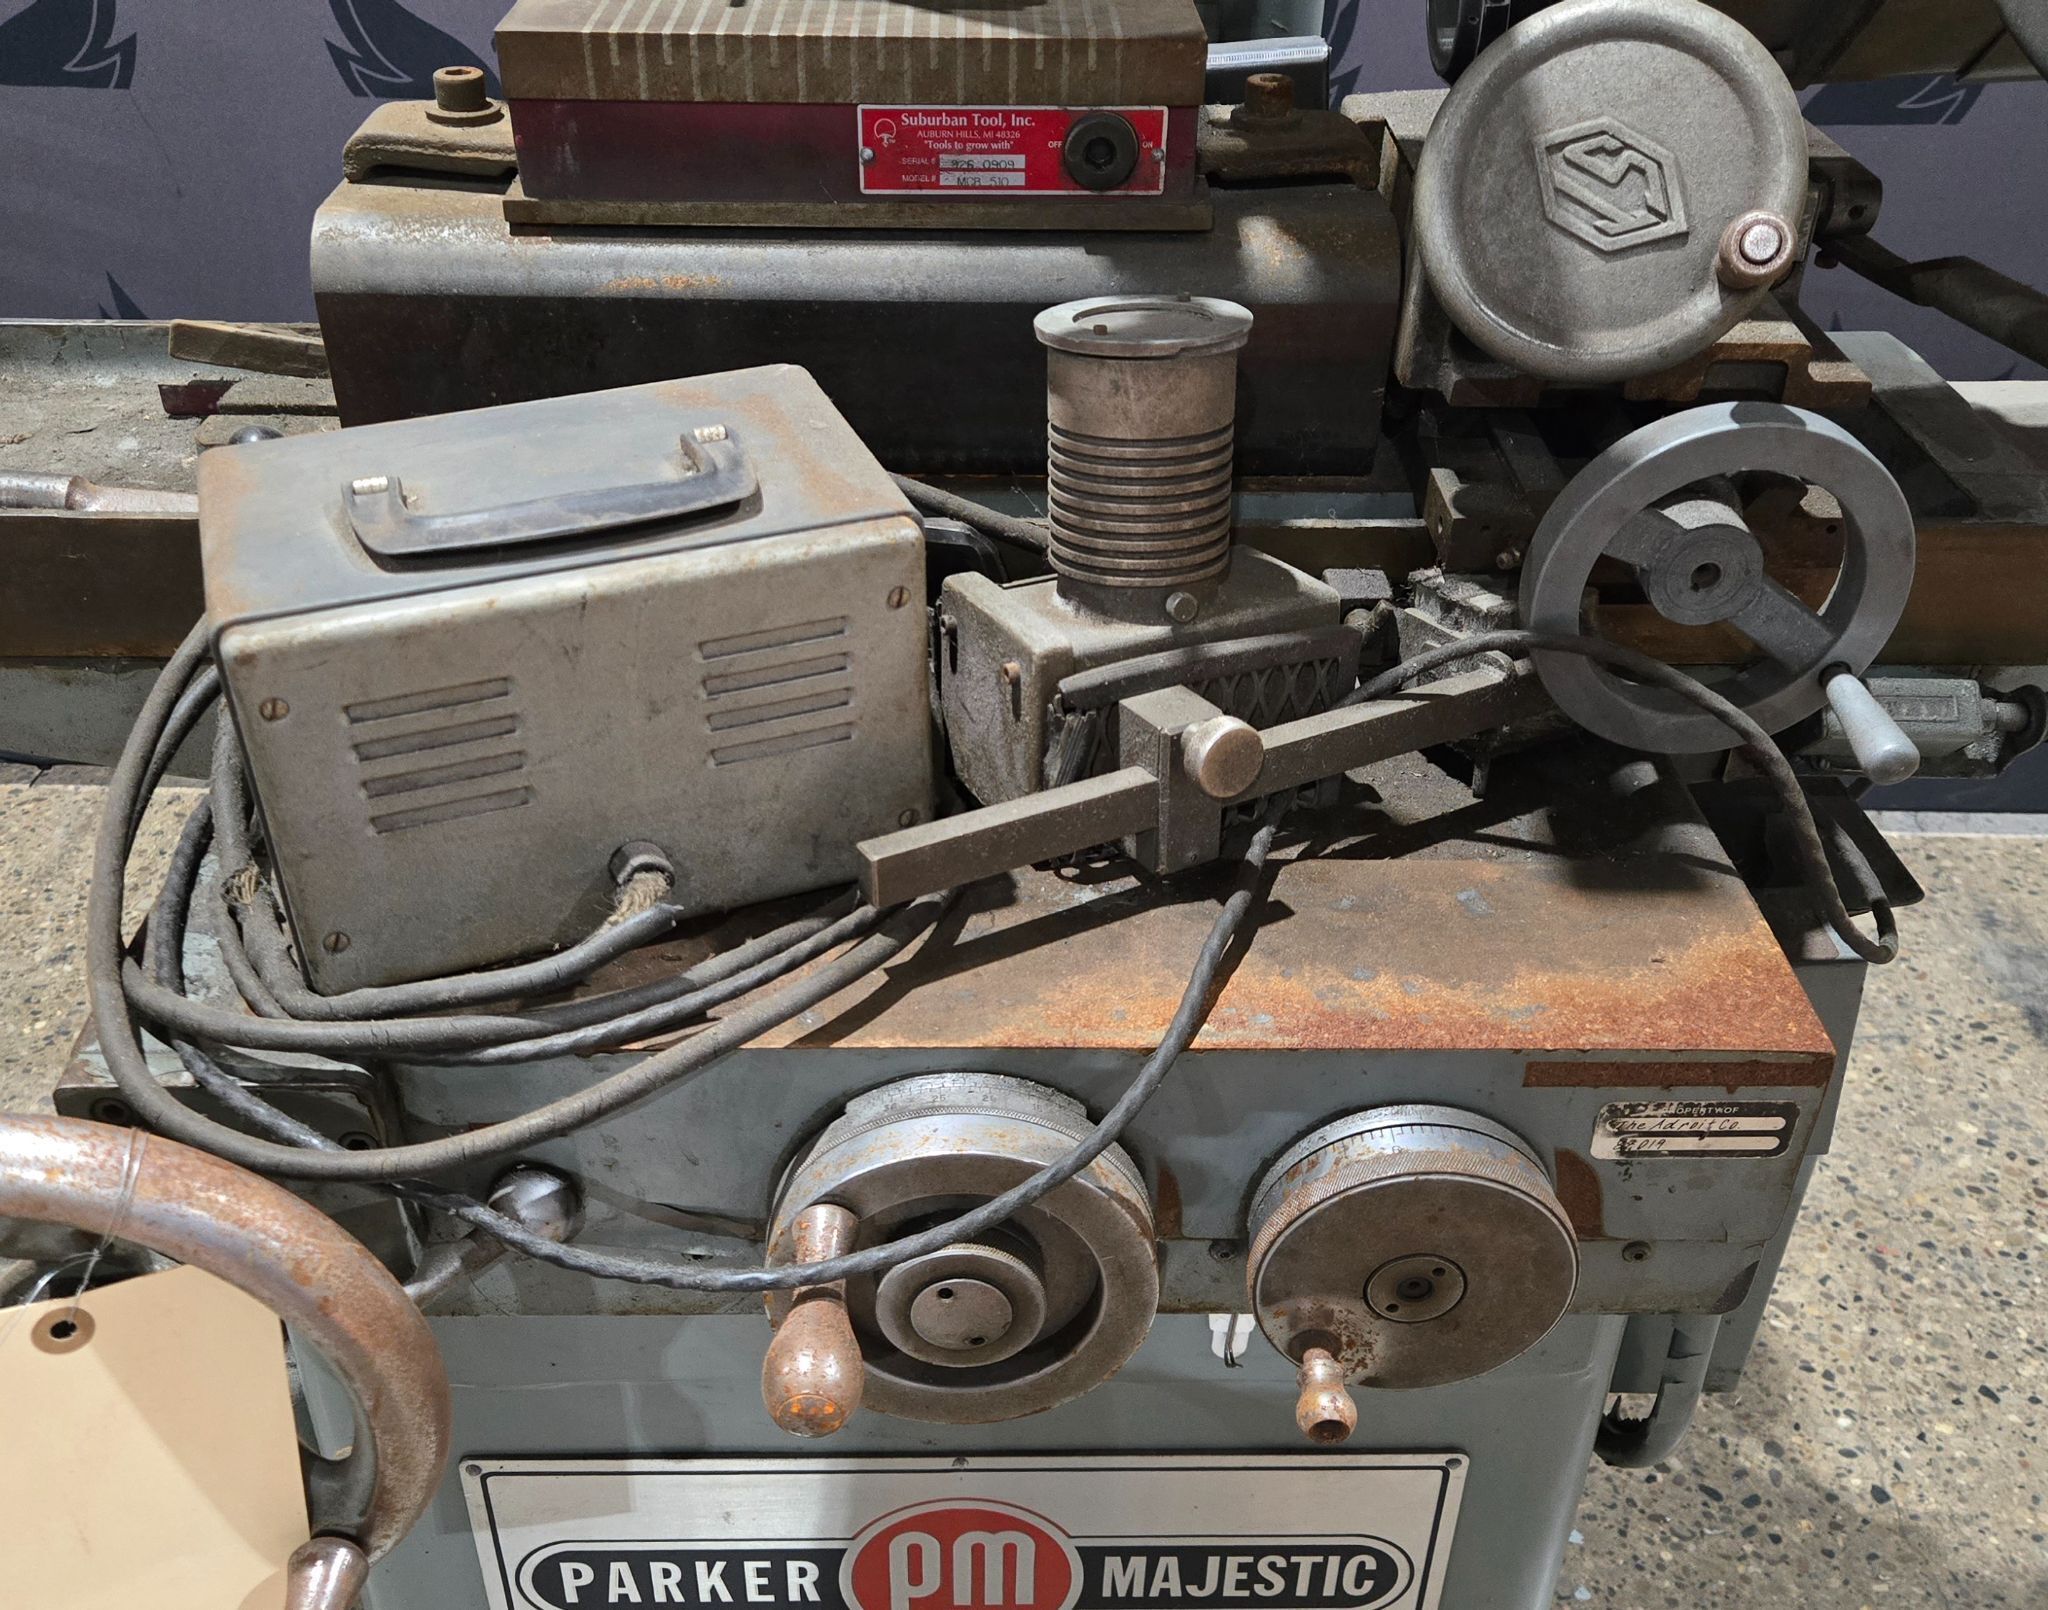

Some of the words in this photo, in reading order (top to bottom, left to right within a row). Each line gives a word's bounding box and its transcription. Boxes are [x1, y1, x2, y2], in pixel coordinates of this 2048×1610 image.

[901, 112, 967, 126] Suburban
[972, 112, 1006, 128] Tool,
[1011, 113, 1036, 126] Inc.
[917, 130, 953, 138] AUBURN
[956, 130, 980, 139] HILLS,
[983, 130, 994, 138] MI
[996, 130, 1020, 139] 48326
[924, 140, 953, 150] "Tools
[954, 141, 964, 150] to
[965, 142, 989, 152] grow
[991, 140, 1014, 150] with"
[1047, 141, 1063, 149] OFF
[1142, 141, 1153, 149] ON
[901, 157, 929, 165] SERIAL
[902, 174, 930, 183] MODEL
[990, 176, 1010, 186] 510
[931, 1094, 947, 1103] 25
[1723, 1106, 1739, 1114] OF
[1616, 1119, 1646, 1131] The
[1650, 1118, 1715, 1131] Adroit
[1719, 1118, 1741, 1131] Co.
[558, 1560, 821, 1604] PARKER
[1102, 1555, 1378, 1598] MAJESTIC
